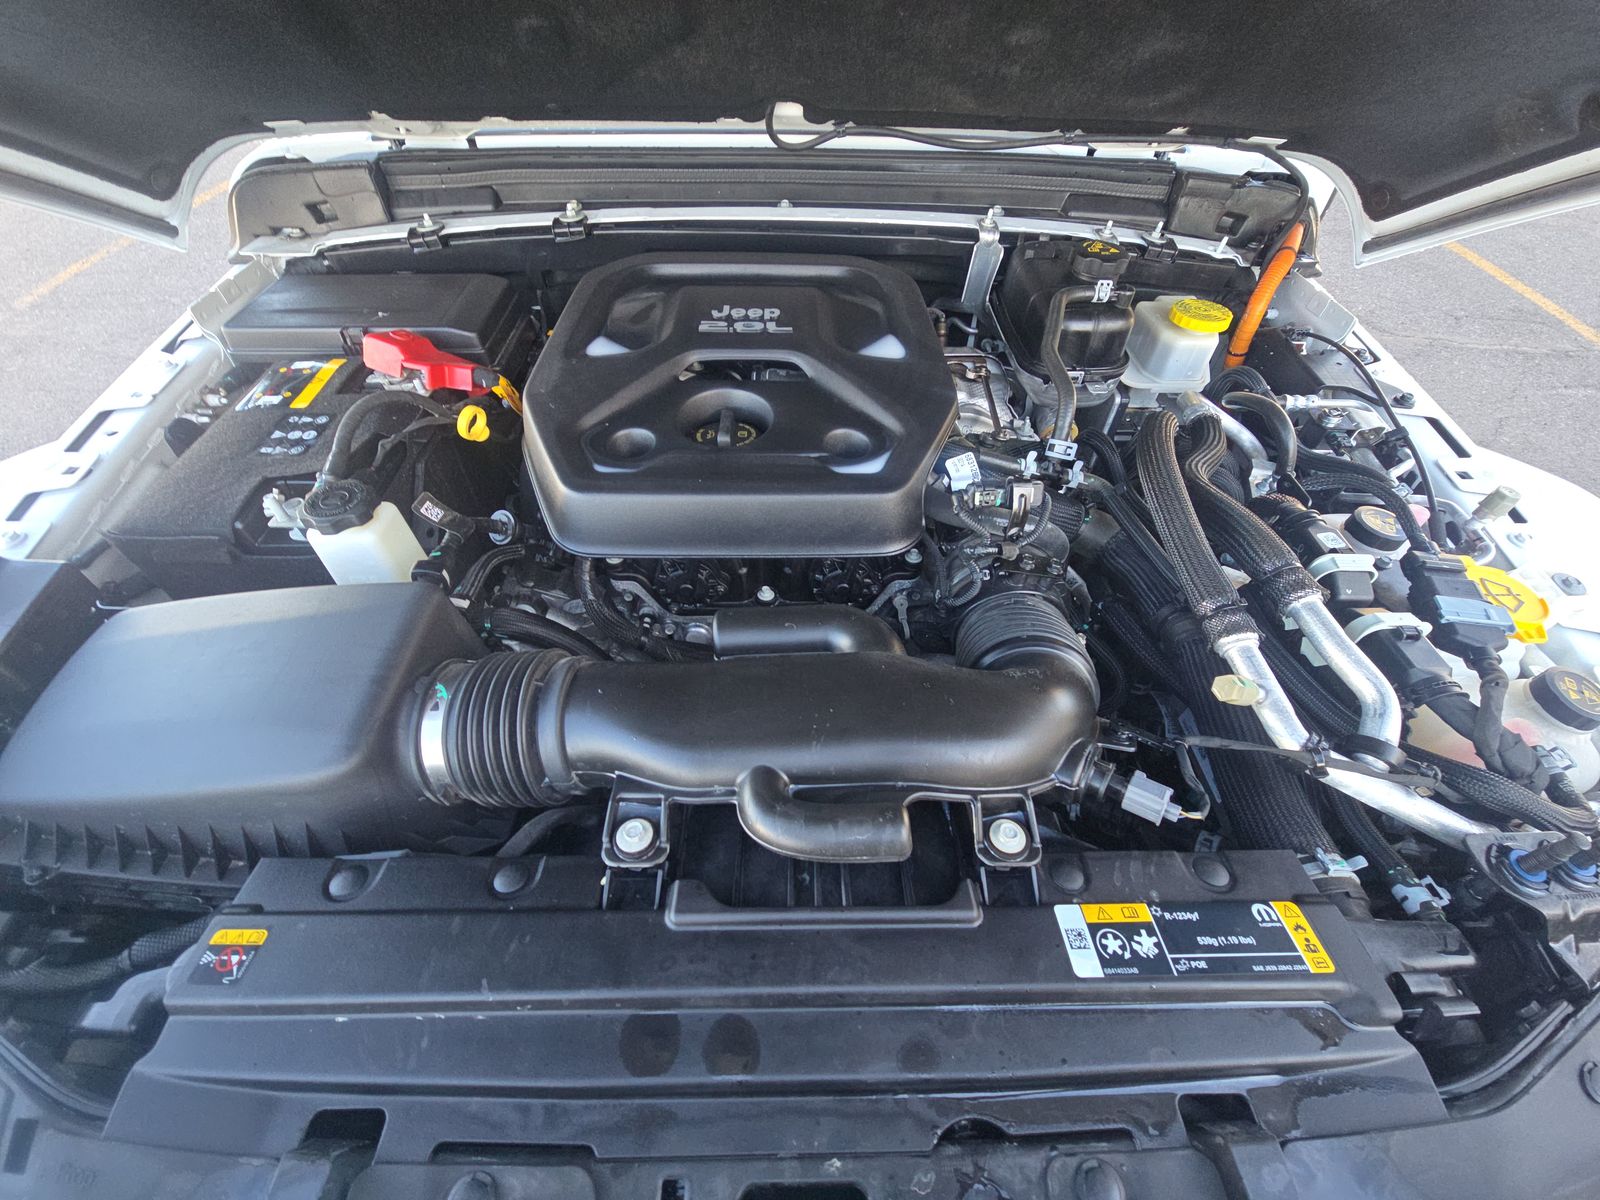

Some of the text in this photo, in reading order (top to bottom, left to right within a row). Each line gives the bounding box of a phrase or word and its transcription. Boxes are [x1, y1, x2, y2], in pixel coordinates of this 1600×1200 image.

[711, 305, 781, 320] Jeep
[698, 320, 793, 334] 2.0L
[1163, 911, 1200, 922] R-1234yf
[1189, 960, 1208, 969] POE
